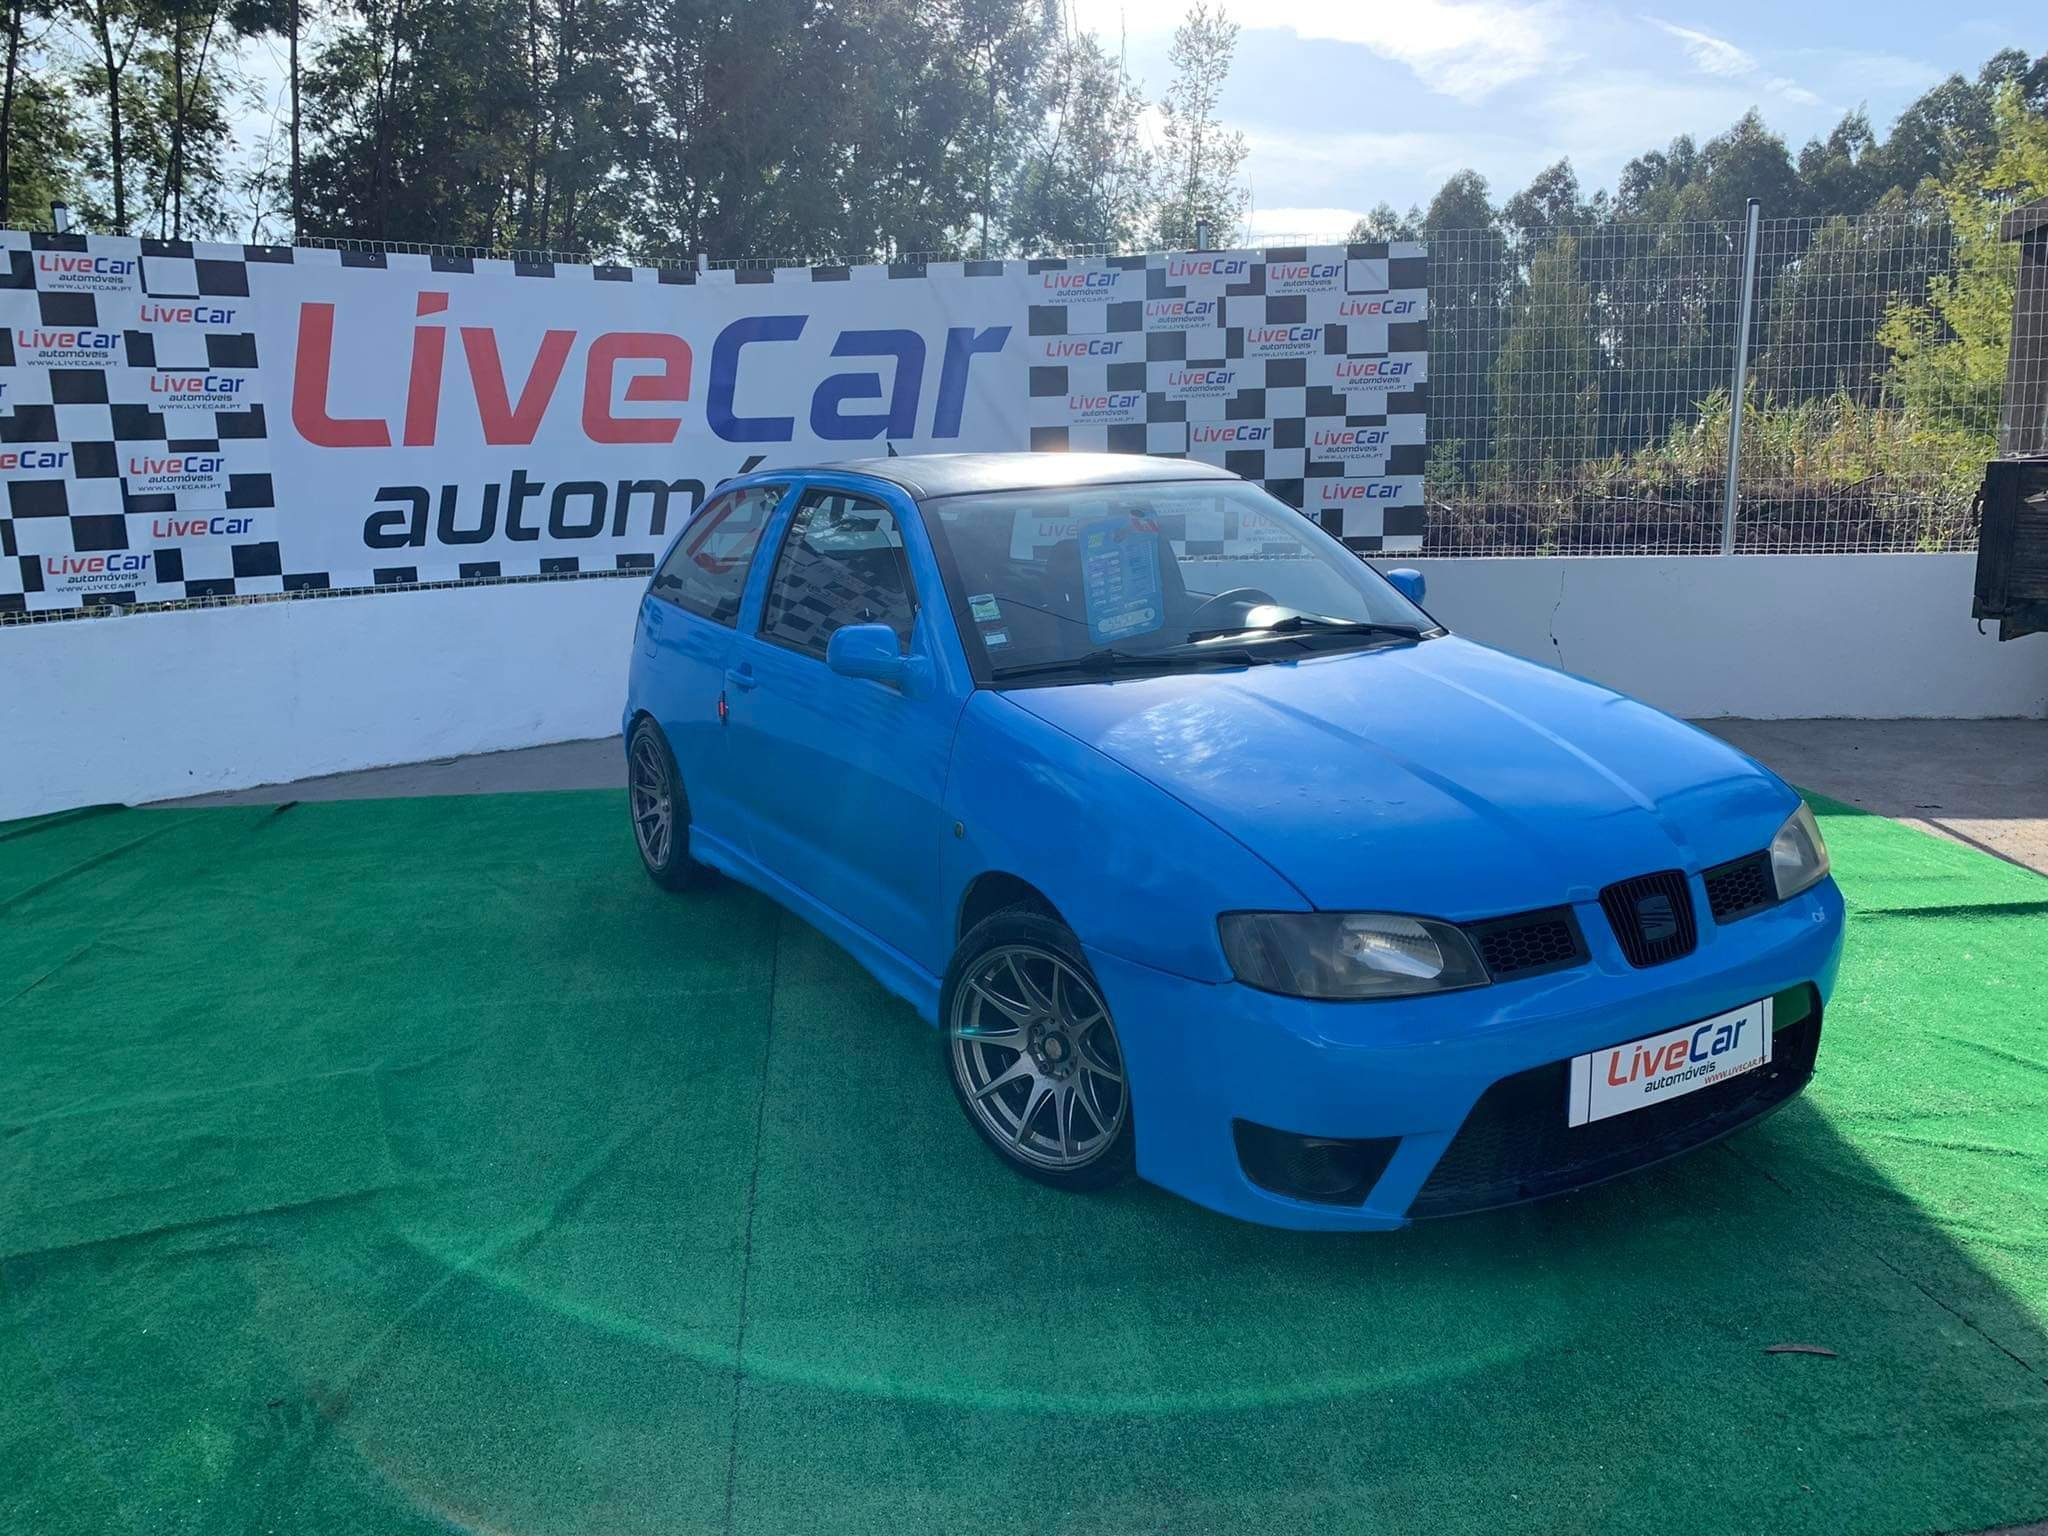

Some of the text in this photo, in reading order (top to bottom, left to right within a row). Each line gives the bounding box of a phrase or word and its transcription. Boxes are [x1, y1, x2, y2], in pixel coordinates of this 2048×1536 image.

[40, 254, 136, 275] LiveCar
[1169, 259, 1247, 277] LiveCar
[1271, 263, 1343, 280] LiveCar
[59, 274, 124, 284] automóveis
[1043, 272, 1120, 289] LiveCar
[140, 303, 236, 324] LiveCar
[1146, 300, 1215, 316] LiveCar
[1339, 299, 1416, 316] LiveCar
[18, 329, 121, 350] LiveCar
[1248, 326, 1322, 343] LiveCar
[38, 349, 109, 359] automóveis
[1046, 339, 1123, 357] LiveCar
[291, 291, 1012, 448] LiveCar
[1336, 360, 1412, 377] LiveCar
[150, 374, 245, 394] LiveCar
[1168, 370, 1235, 386] LiveCar
[169, 392, 232, 402] automóveis
[1069, 394, 1139, 410] LiveCar
[1193, 425, 1271, 443] LiveCar
[1314, 429, 1389, 446] LiveCar
[0, 450, 69, 470] eCar
[130, 455, 225, 475] LiveCar
[149, 473, 213, 484] automóveis
[1322, 482, 1402, 500] LiveCar
[152, 516, 254, 538] LiveCar
[47, 553, 152, 575] LiveCar
[67, 572, 138, 584] automóveis
[1607, 1018, 1747, 1087] LiveCar
[1644, 1060, 1716, 1093] automóveis
[1704, 1054, 1768, 1085] WWW.LIVECAR.PT
